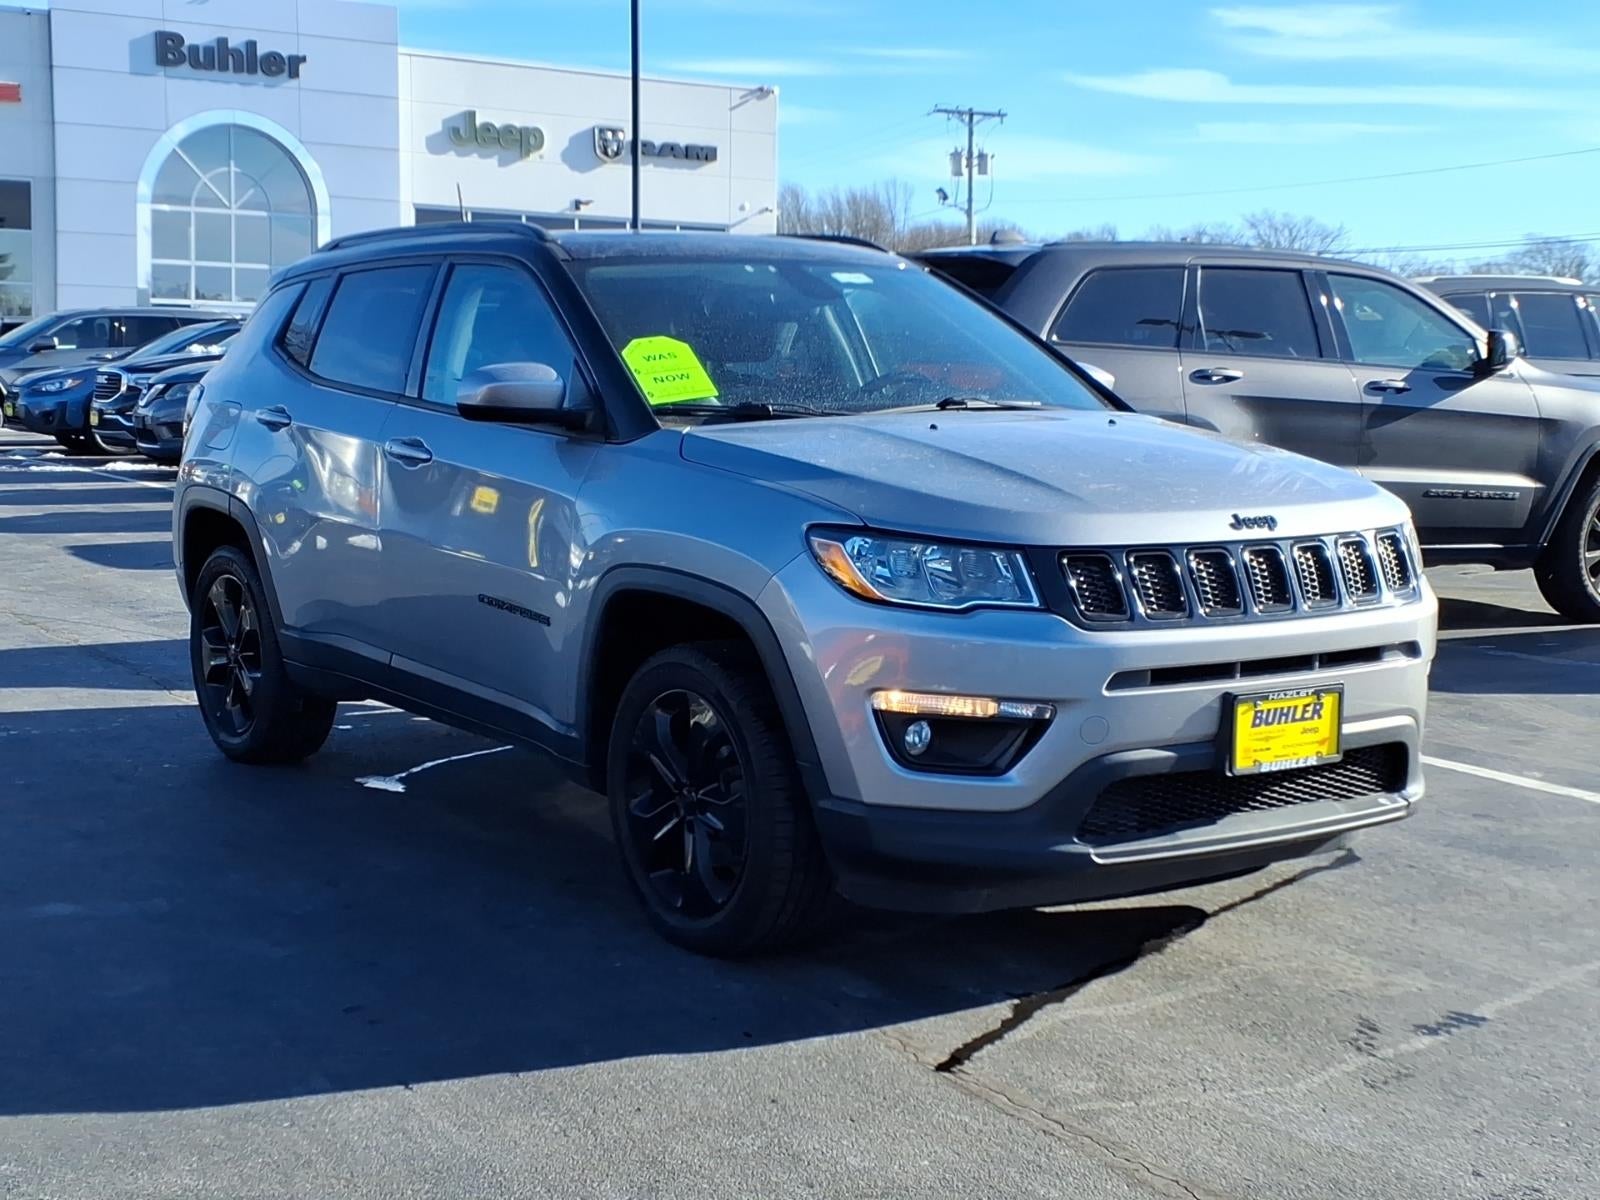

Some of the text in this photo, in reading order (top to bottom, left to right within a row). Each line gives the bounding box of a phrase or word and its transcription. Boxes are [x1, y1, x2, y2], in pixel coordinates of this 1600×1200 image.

[155, 30, 307, 79] Buhler
[450, 110, 544, 159] Jeep
[635, 140, 717, 162] RAM
[642, 352, 678, 362] WAS
[653, 373, 690, 384] NOW
[1228, 513, 1277, 532] Jeep
[1251, 702, 1324, 728] BUHLER
[1260, 756, 1318, 772] BUHLER
